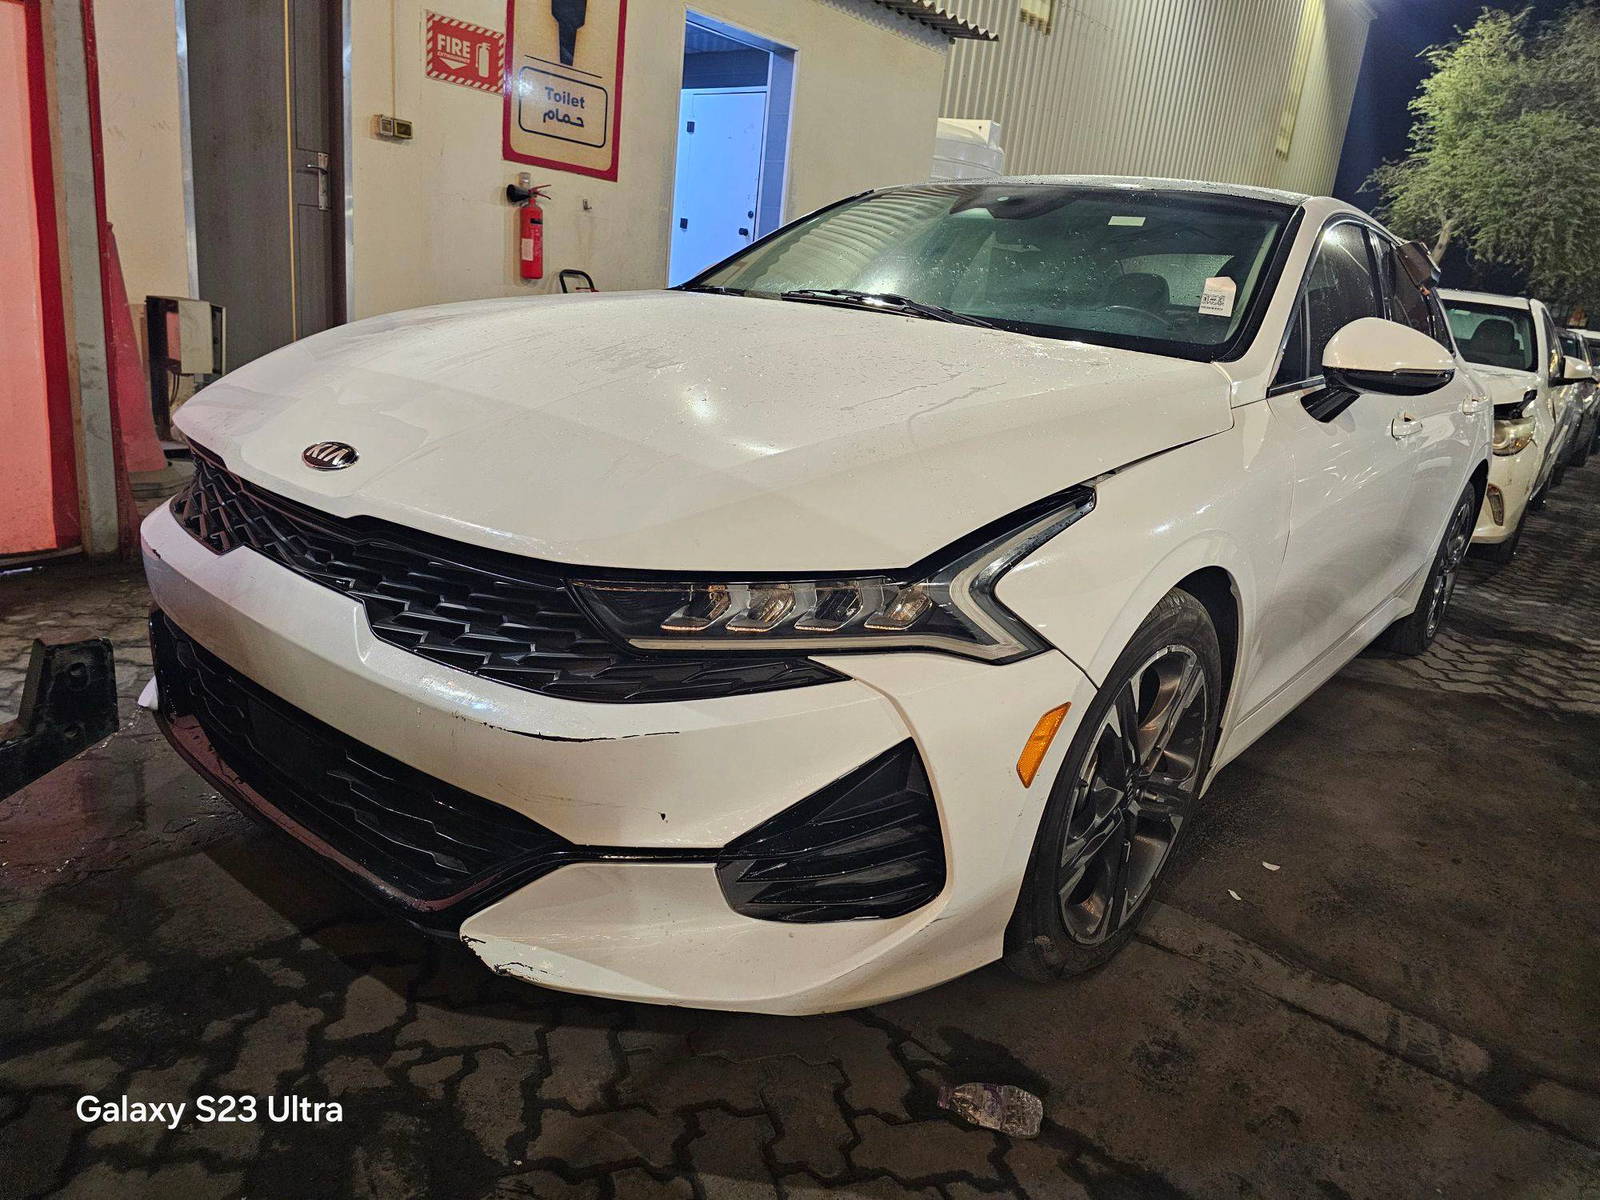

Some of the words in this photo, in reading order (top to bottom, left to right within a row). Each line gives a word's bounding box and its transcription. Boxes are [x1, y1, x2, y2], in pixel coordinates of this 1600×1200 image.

[437, 33, 470, 58] FIRE
[544, 86, 585, 109] Toilet
[543, 108, 584, 128] حمام
[306, 443, 348, 465] KIA
